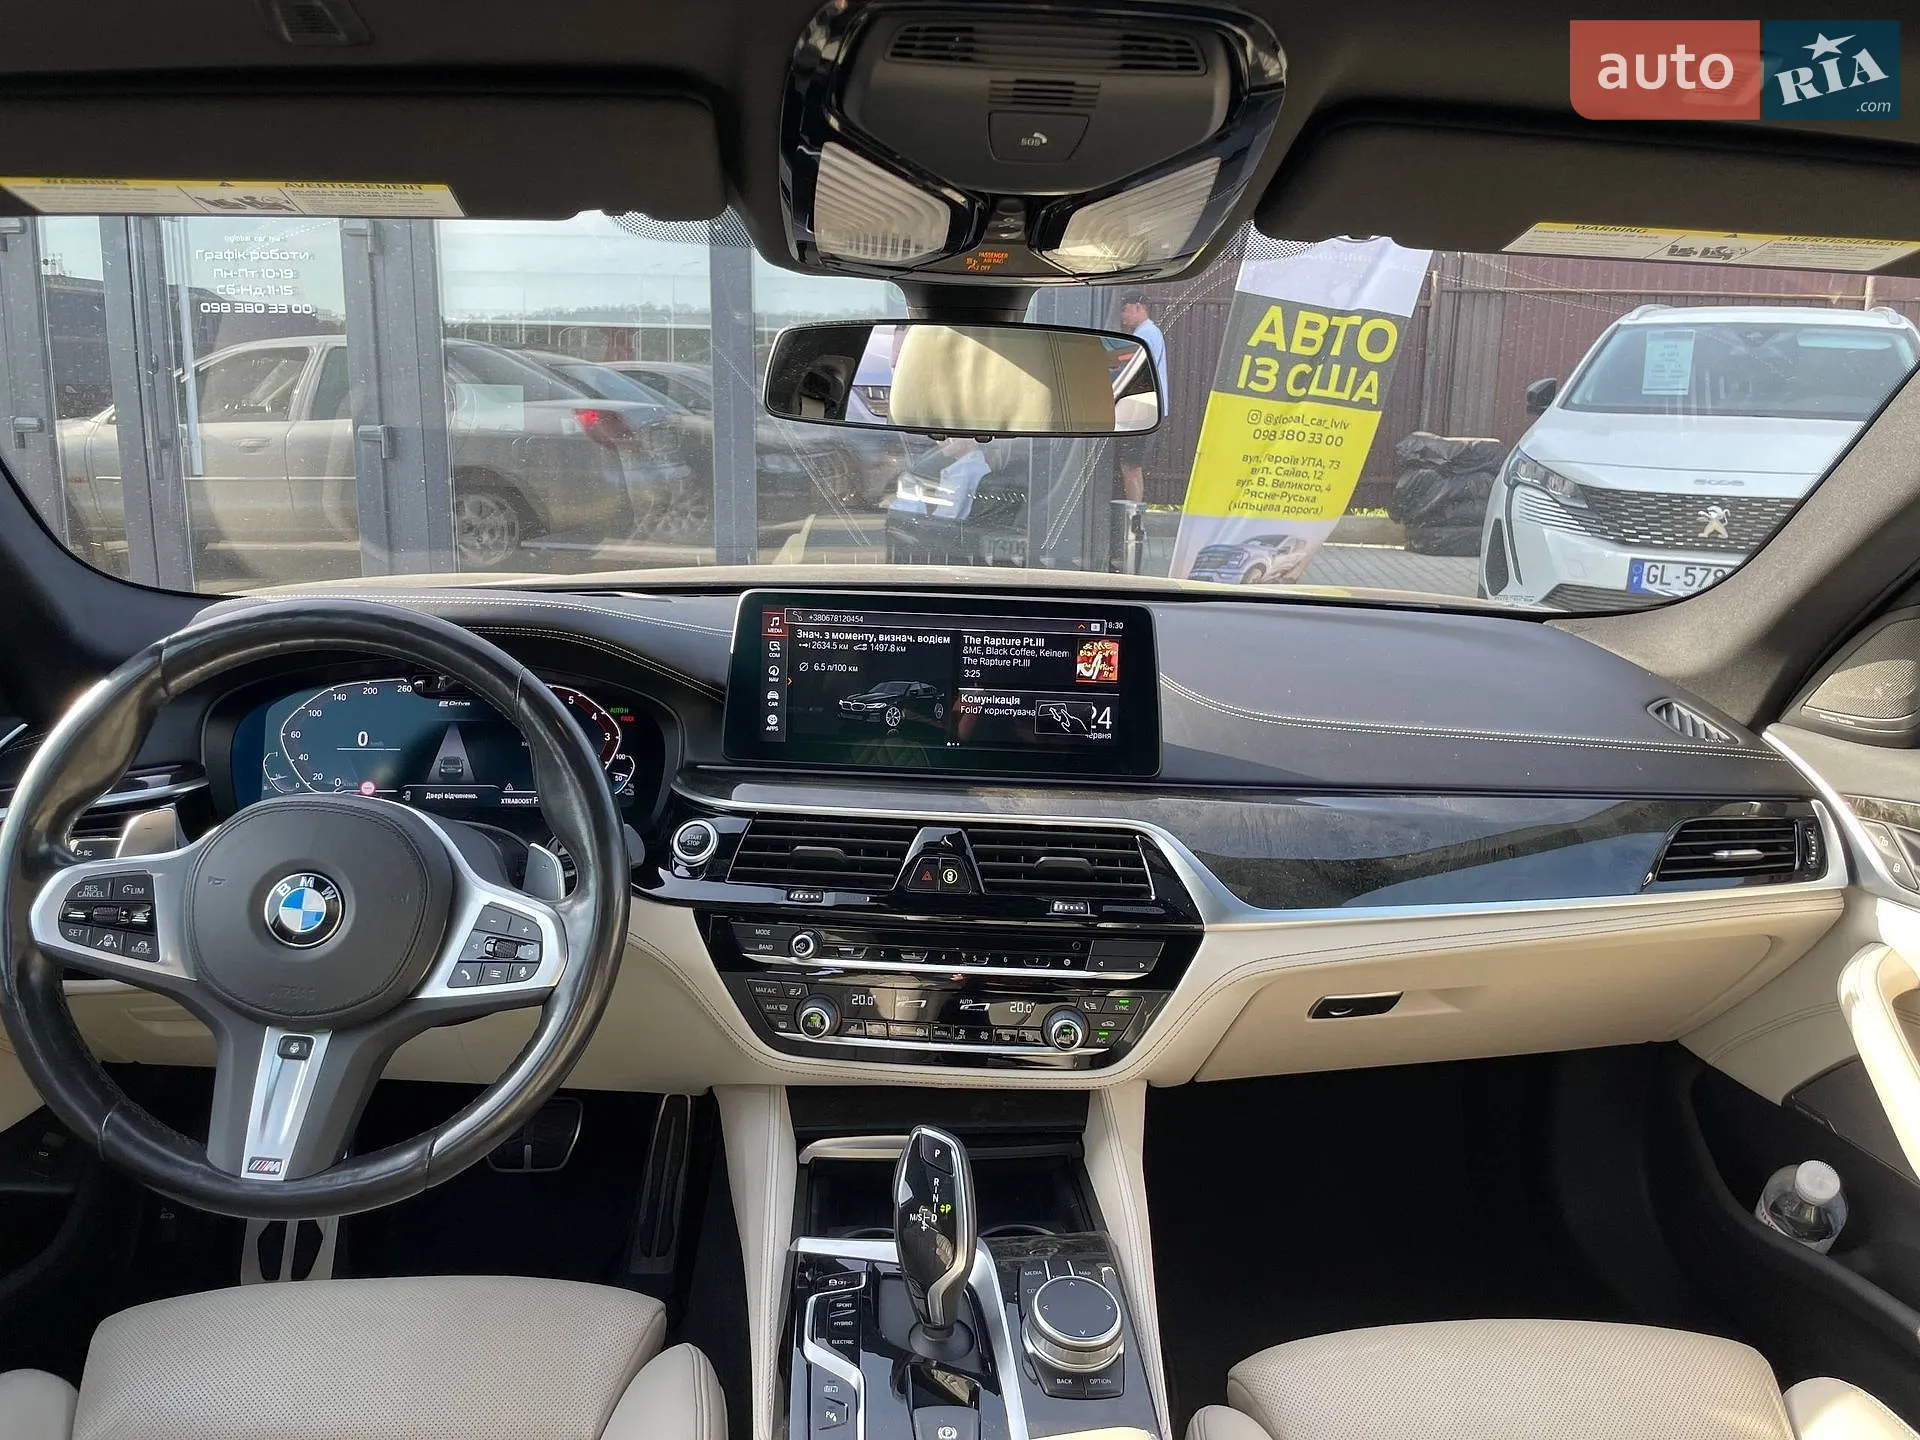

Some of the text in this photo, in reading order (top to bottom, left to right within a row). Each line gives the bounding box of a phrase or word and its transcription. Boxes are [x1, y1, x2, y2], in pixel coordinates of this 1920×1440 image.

[1020, 137, 1040, 146] SOS
[284, 182, 424, 191] AVERTISSEMENT
[1576, 225, 1648, 233] WARNING
[195, 248, 246, 262] Графік
[213, 268, 294, 278] Пн-Пт 10-19
[200, 303, 231, 313] 098
[234, 303, 265, 313] 380
[268, 303, 288, 314] 33
[1247, 305, 1399, 364] АВТО
[1236, 354, 1380, 405] ІЗ США
[1252, 428, 1277, 441] 098
[1307, 432, 1322, 444] 33
[1325, 434, 1344, 447] 00
[1328, 459, 1341, 470] 73
[1313, 470, 1324, 480] 12
[808, 613, 864, 623] +380678120454
[796, 629, 951, 645] Знач. з моменту, визнач. водієм
[963, 635, 1045, 648] The Rapture Pt.III
[812, 640, 838, 650] 2634.5
[870, 644, 895, 652] 1497.8
[962, 647, 984, 656] &ME,
[986, 646, 1008, 655] Black
[1009, 648, 1038, 658] Coffee,
[1039, 649, 1070, 658] Keinem
[813, 662, 826, 671] 6.5
[827, 663, 847, 672] л/100
[962, 656, 1031, 669] The Rapture Pt.III
[964, 669, 981, 678] 3:25
[362, 687, 378, 695] 200
[397, 685, 413, 693] 260
[332, 693, 347, 701] 140
[568, 696, 575, 704] 5
[960, 693, 1021, 706] Комунікація
[308, 709, 322, 717] 100
[591, 712, 598, 720] 4
[960, 705, 1037, 718] Fold7 користувача
[290, 730, 301, 738] 60
[604, 732, 611, 741] 3
[357, 731, 369, 747] 0
[298, 753, 309, 761] 40
[312, 772, 323, 781] 20
[334, 778, 342, 787] 0
[425, 791, 479, 800] Двері відчинено.
[84, 884, 98, 892] RES
[130, 887, 145, 895] LIM
[276, 876, 337, 901] BMW
[77, 890, 104, 898] CANCEL
[68, 928, 83, 937] SET
[755, 928, 771, 936] MODE
[130, 945, 152, 954] MODE
[758, 943, 773, 951] BAND
[755, 986, 769, 994] MAX
[766, 1003, 778, 1011] MAX
[1114, 1003, 1129, 1012] SYNC
[934, 1148, 941, 1158] P
[933, 1177, 940, 1187] R
[932, 1193, 939, 1203] N
[945, 1204, 952, 1214] P
[909, 1213, 938, 1223] M/S D
